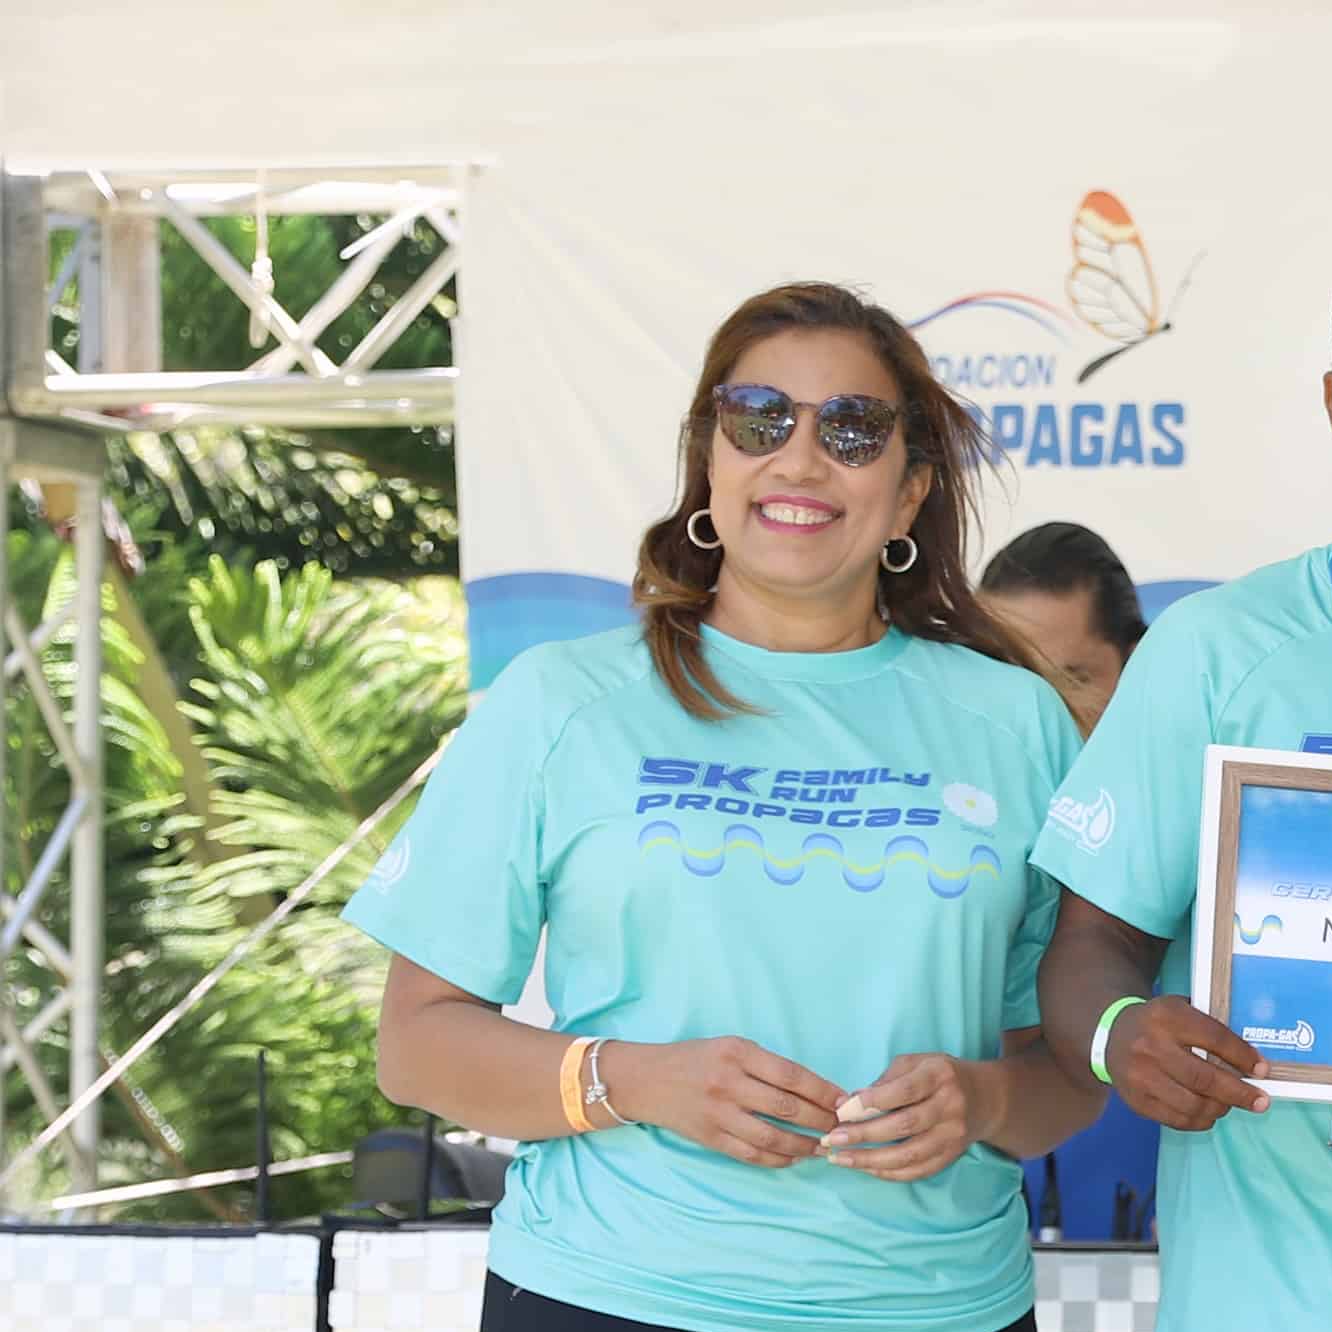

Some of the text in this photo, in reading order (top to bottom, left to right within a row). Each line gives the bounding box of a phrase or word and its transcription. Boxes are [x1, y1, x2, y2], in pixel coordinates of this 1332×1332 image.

[774, 767, 932, 787] FAMILY
[770, 786, 858, 804] RUN
[635, 792, 941, 828] PROPAGAS
